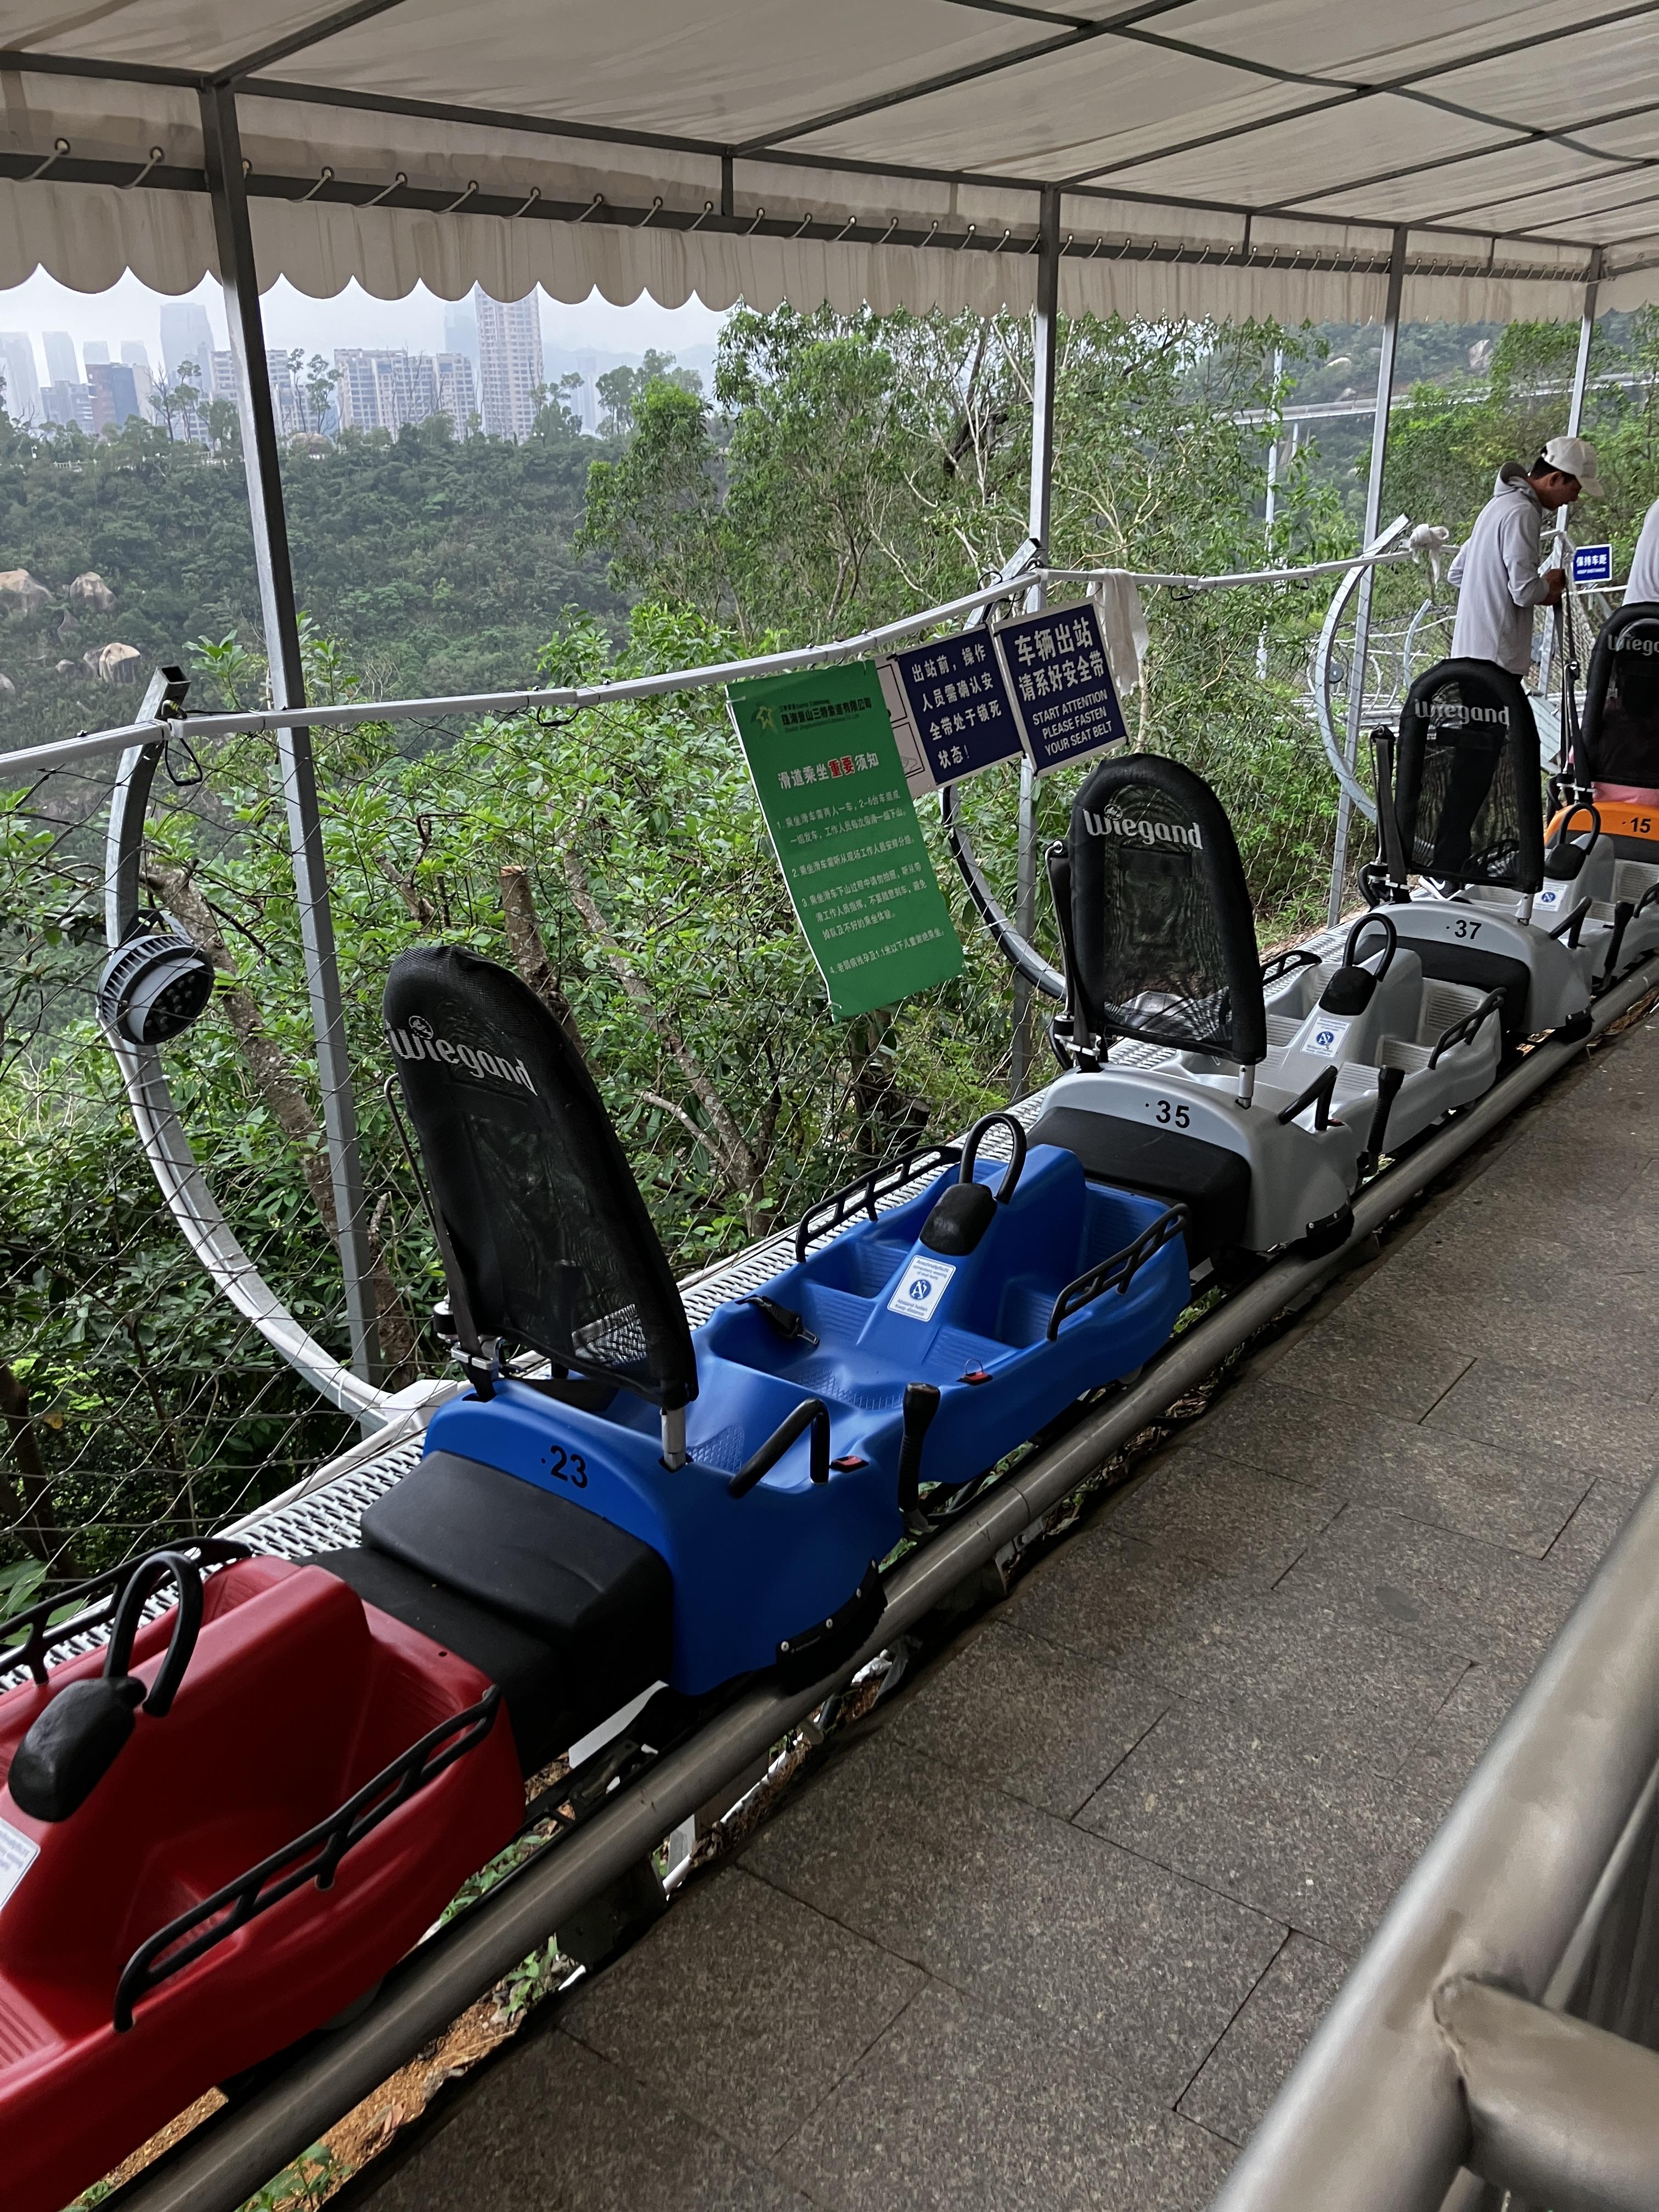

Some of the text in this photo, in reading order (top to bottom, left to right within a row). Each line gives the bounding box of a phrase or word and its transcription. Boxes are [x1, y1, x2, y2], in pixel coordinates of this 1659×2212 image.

[1014, 617, 1093, 667] 车辆出站
[912, 643, 986, 683] 出站前，操作
[1019, 650, 1104, 702] 请系好安全带
[922, 672, 994, 713] 人员需确认安
[1032, 689, 1108, 726] START ATTENTION
[929, 699, 1002, 742] 全带处于锁死
[1042, 707, 1107, 740] PLEASE FASTEN
[1415, 698, 1510, 726] Wiegand
[1044, 720, 1113, 757] YOUR SEAT BELT
[777, 752, 879, 789] 滑道乘坐重要须知
[1082, 805, 1204, 850] Wiegand
[1630, 817, 1651, 833] 15
[1454, 919, 1482, 939] 37
[385, 1017, 538, 1096] Wiegand
[1156, 1100, 1190, 1128] 35
[550, 1444, 588, 1489] 23
